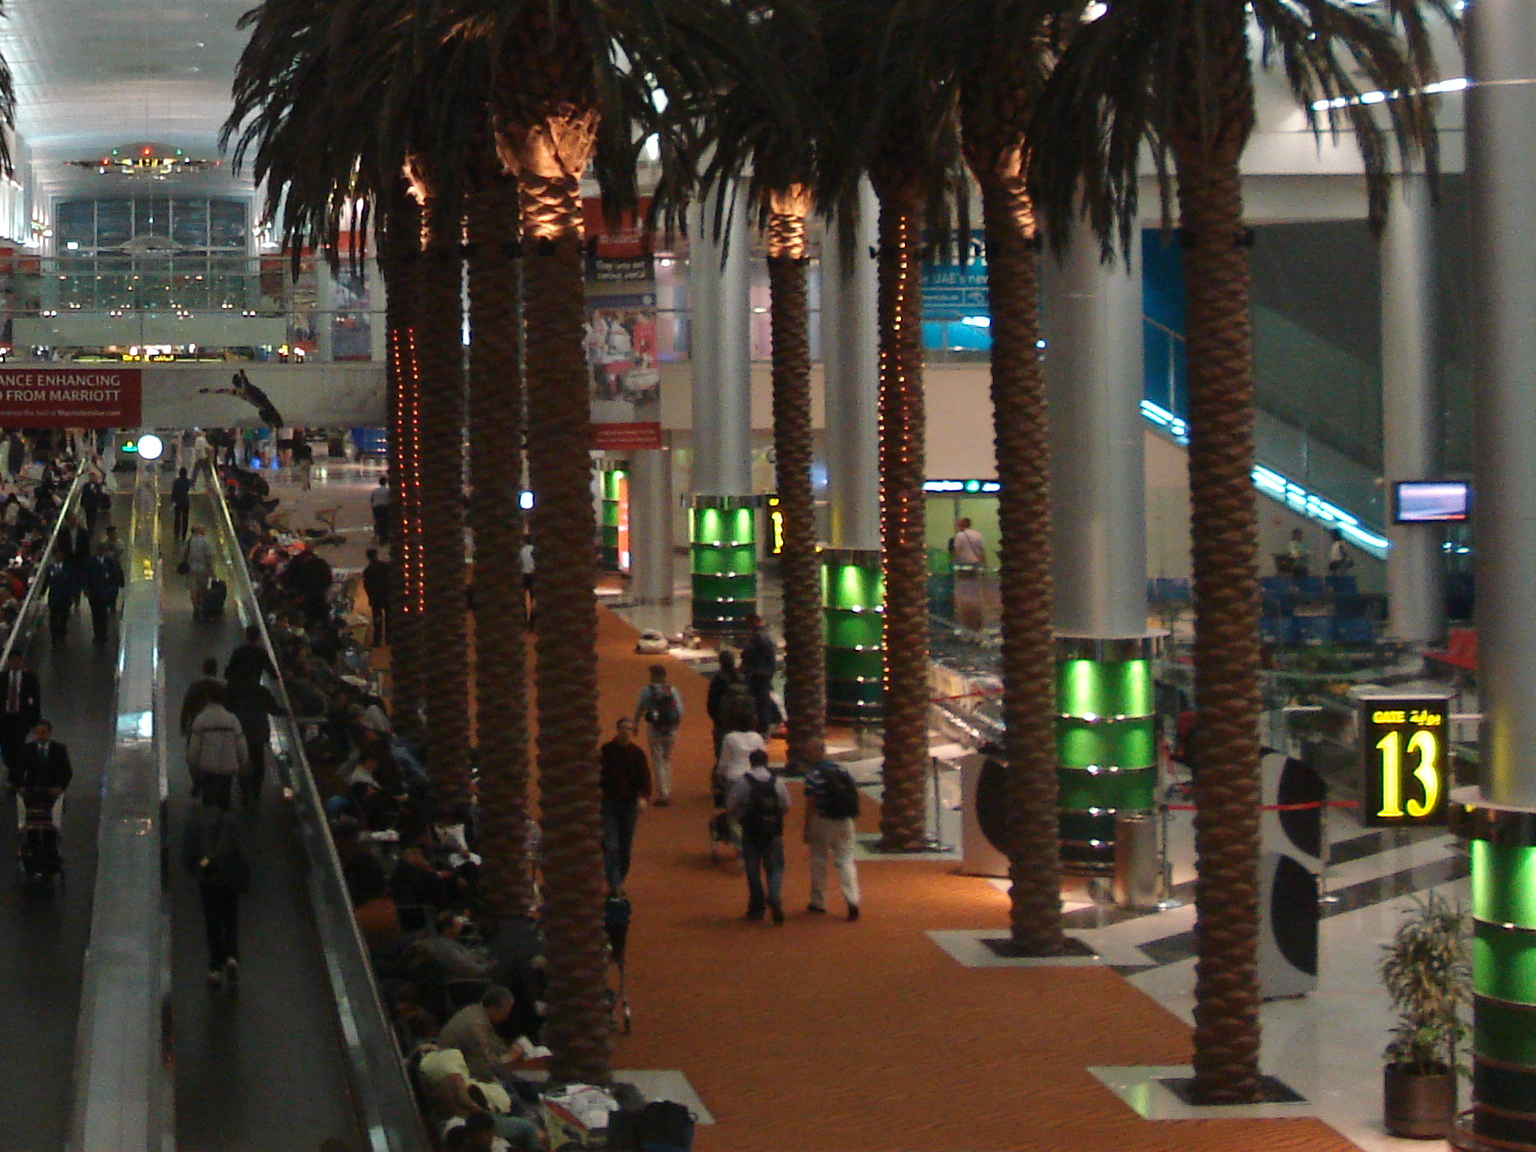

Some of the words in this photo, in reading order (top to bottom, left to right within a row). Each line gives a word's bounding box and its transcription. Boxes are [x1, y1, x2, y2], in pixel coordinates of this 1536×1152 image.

[37, 374, 121, 387] ENHANCING
[6, 390, 46, 402] FROM
[49, 390, 121, 402] MARRIOTT
[1372, 710, 1406, 724] GATE
[1375, 729, 1439, 817] 13
